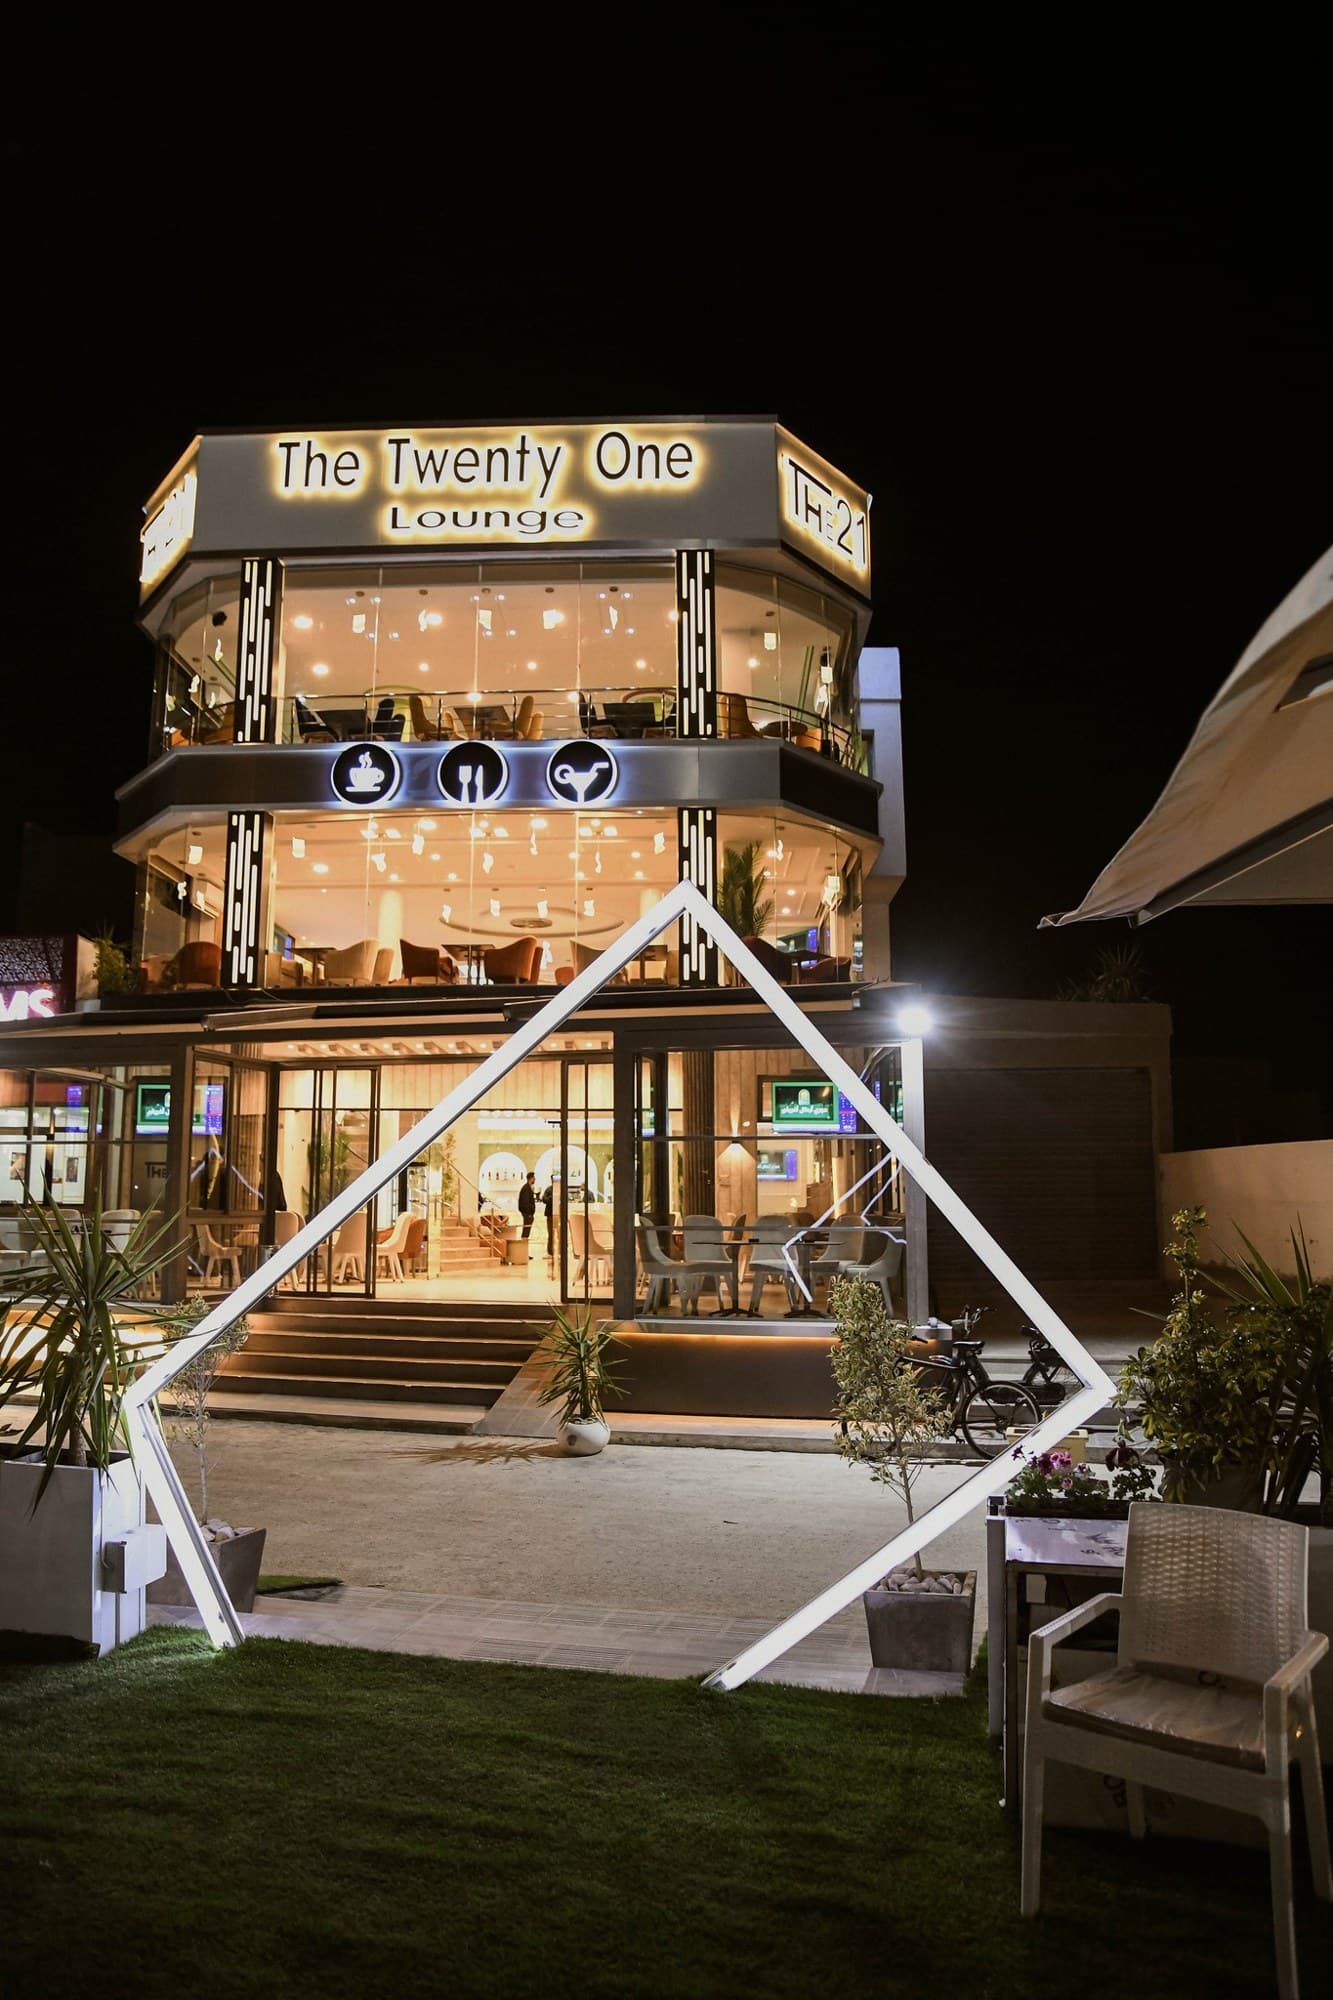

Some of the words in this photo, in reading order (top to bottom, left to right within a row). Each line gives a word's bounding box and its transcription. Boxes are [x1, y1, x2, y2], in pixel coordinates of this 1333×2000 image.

[278, 440, 361, 488] The
[387, 437, 562, 498] Twenty
[595, 431, 694, 480] One
[391, 506, 585, 534] Lounge
